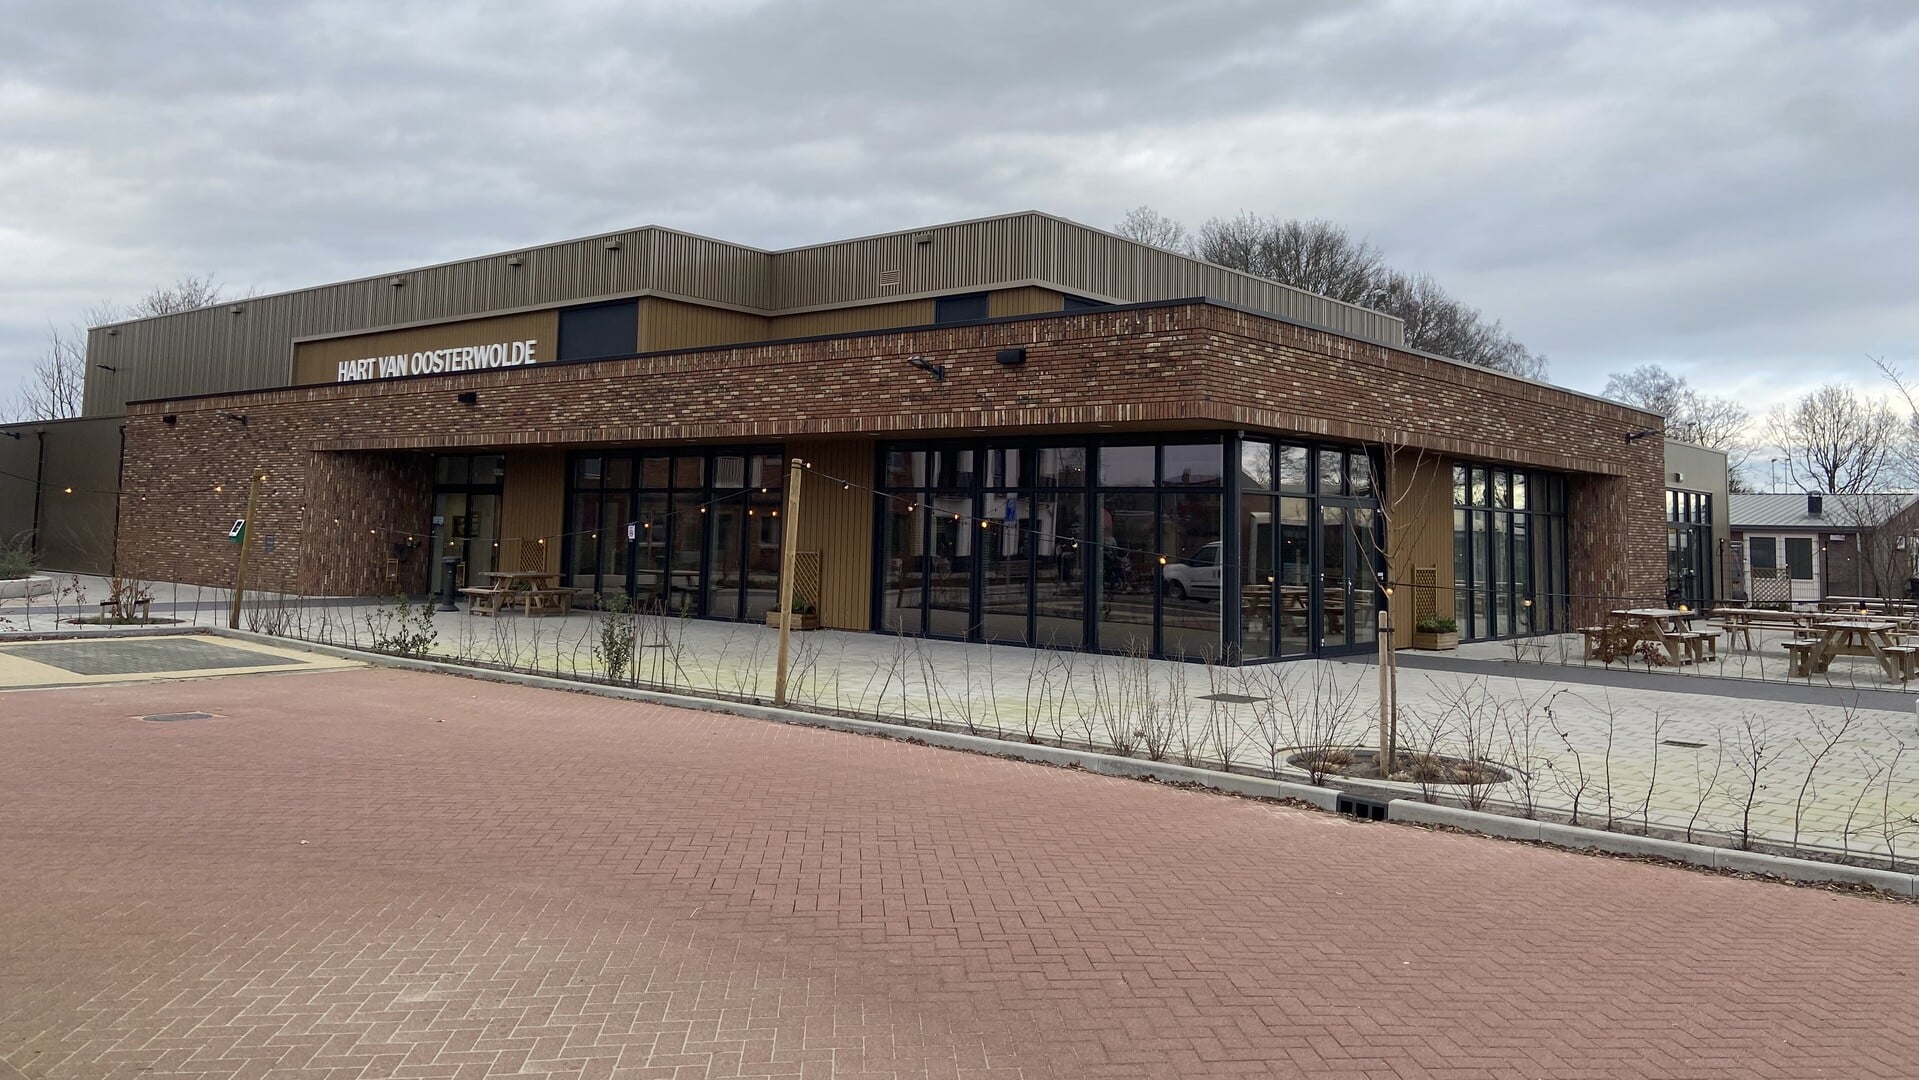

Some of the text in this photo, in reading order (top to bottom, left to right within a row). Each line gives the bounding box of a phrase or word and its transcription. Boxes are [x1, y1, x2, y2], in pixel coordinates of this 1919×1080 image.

[338, 340, 537, 382] HART VAN OOSTERWOLDE
